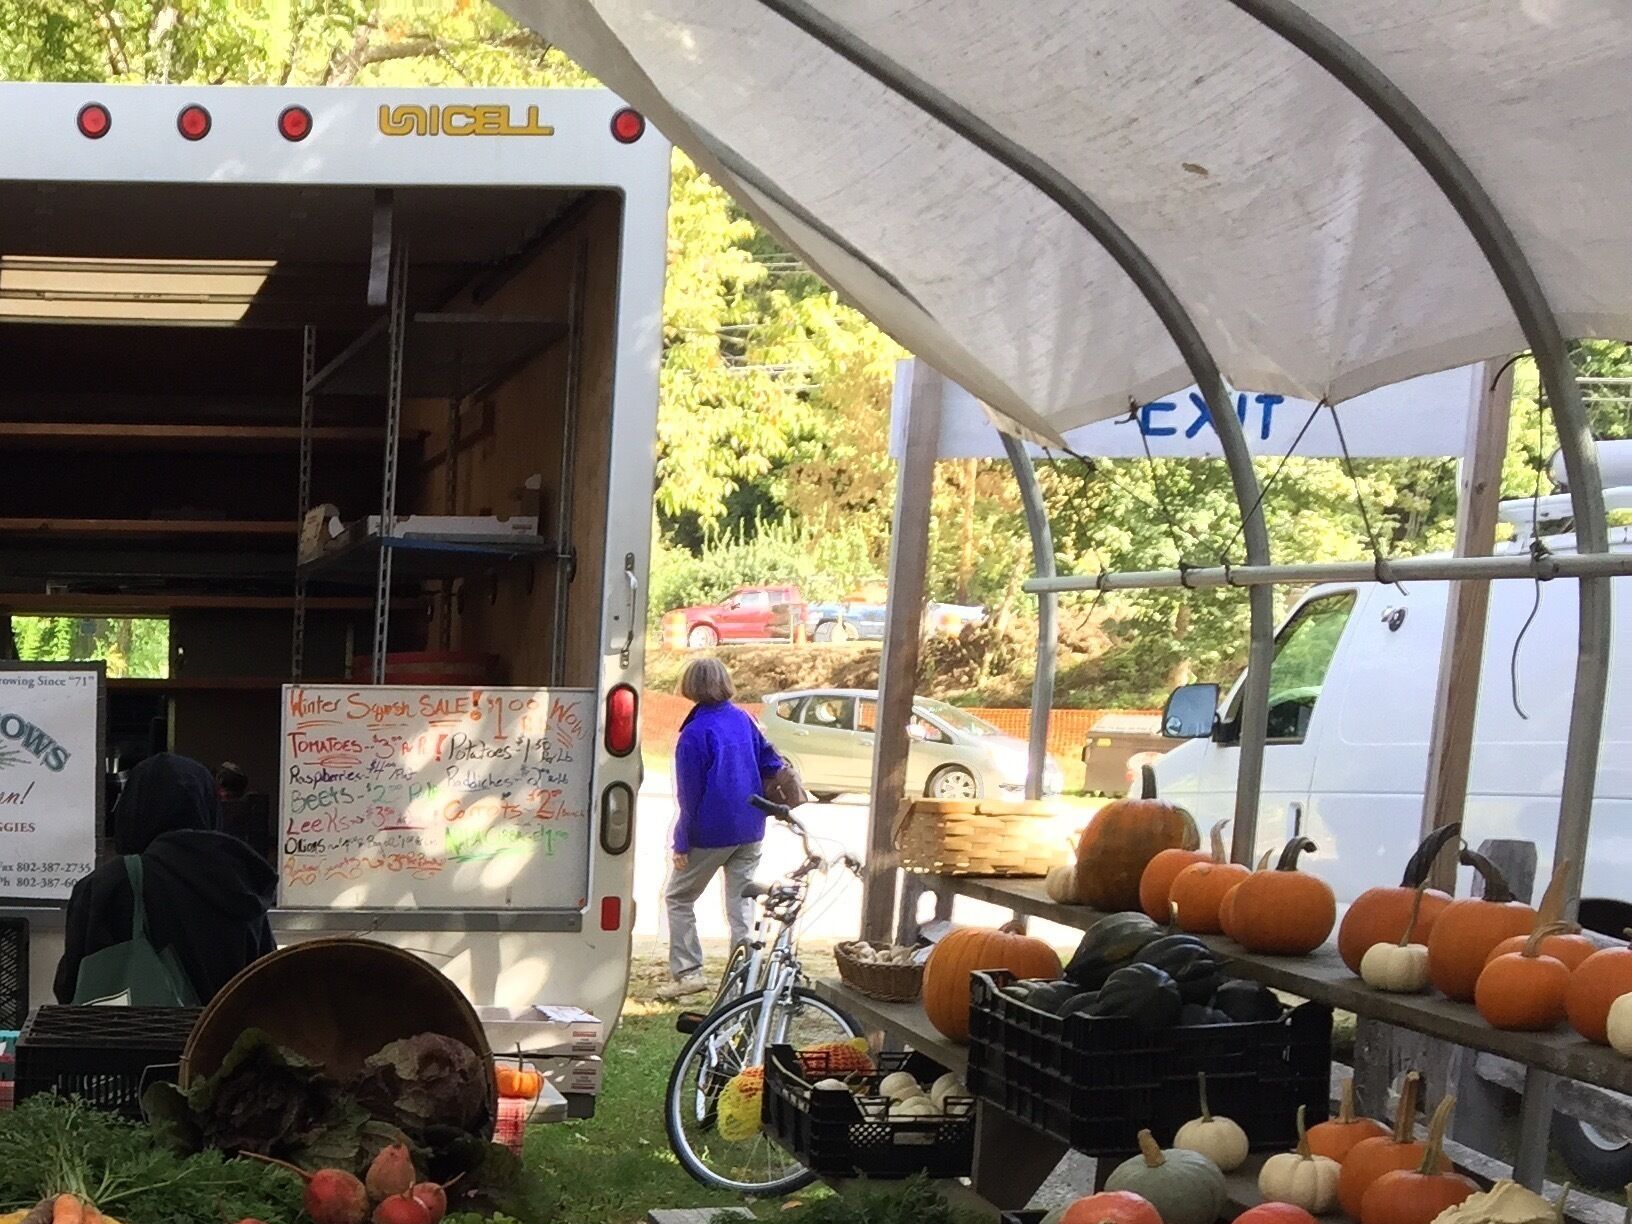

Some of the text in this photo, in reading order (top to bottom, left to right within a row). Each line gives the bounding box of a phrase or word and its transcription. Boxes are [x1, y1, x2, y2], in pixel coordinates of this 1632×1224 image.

[379, 104, 554, 136] UNICELL
[1142, 392, 1284, 440] EXIT
[37, 675, 66, 687] Since
[290, 688, 341, 717] Winter
[347, 693, 416, 722] Squash
[420, 690, 483, 721] SALE!
[448, 732, 512, 761] Potatoes
[290, 764, 363, 790] Raspberries
[16, 862, 91, 873] 802-387-2735
[16, 877, 79, 888] 802-387-60
